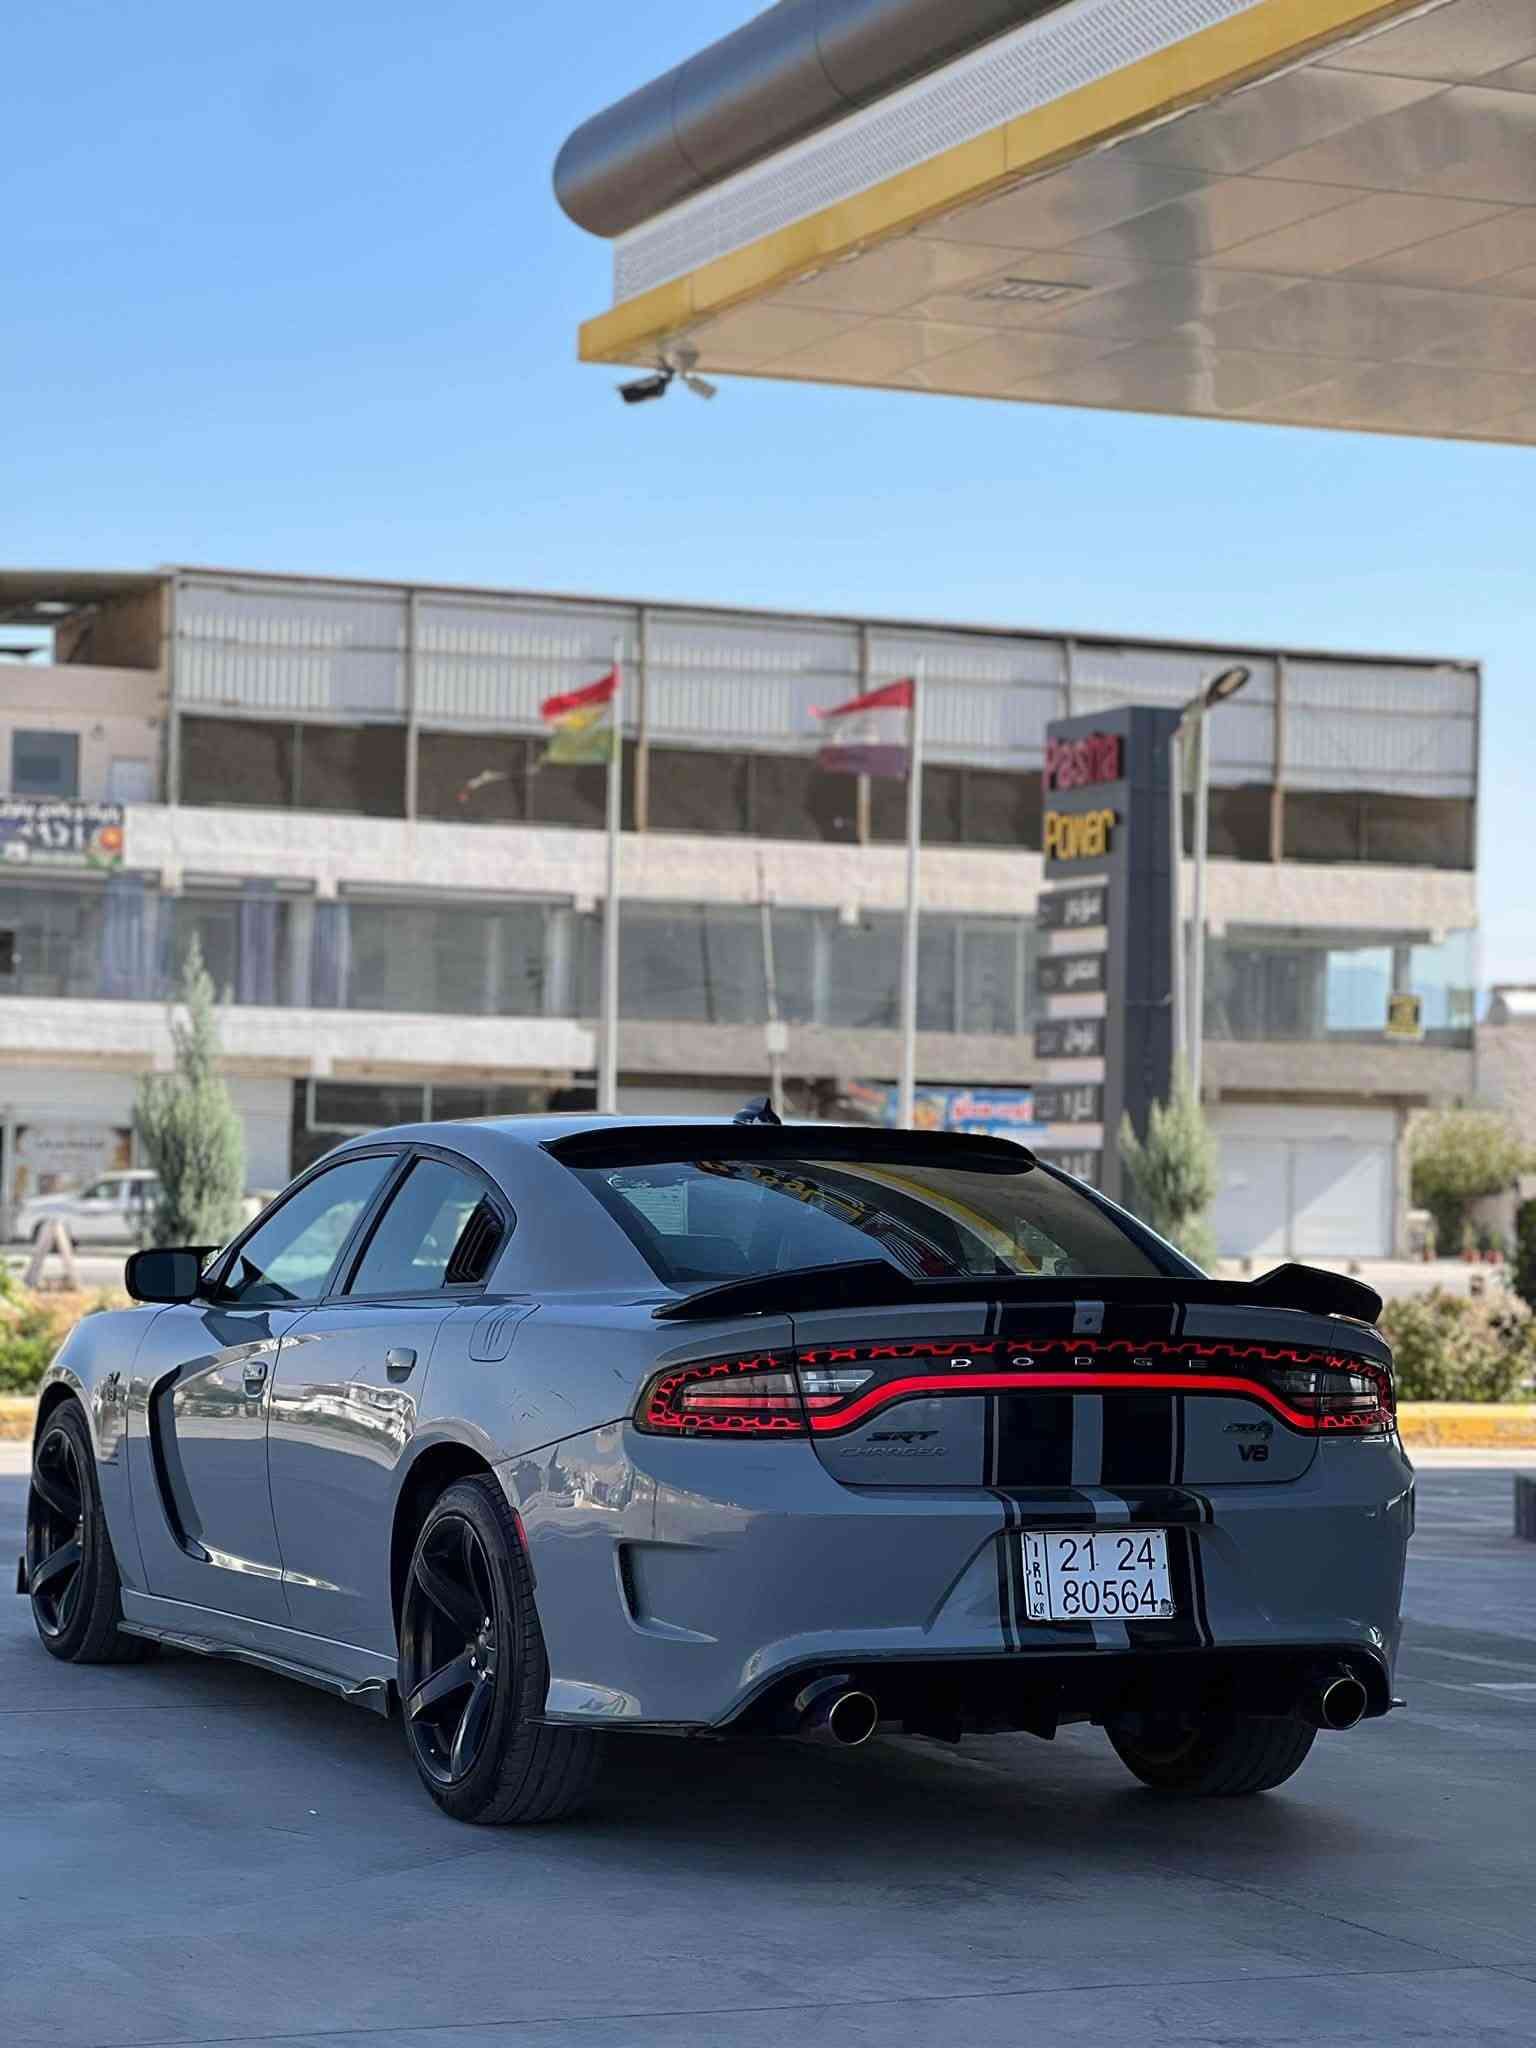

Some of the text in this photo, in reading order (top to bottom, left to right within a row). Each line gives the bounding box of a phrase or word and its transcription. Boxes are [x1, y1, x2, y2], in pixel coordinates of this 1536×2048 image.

[1043, 808, 1115, 859] Power
[951, 1356, 1207, 1368] DODGE
[866, 1430, 939, 1443] SRT
[840, 1447, 945, 1456] CHARGER
[1238, 1444, 1269, 1461] V8
[1059, 1537, 1156, 1572] 21 24
[1062, 1578, 1159, 1615] 80564
